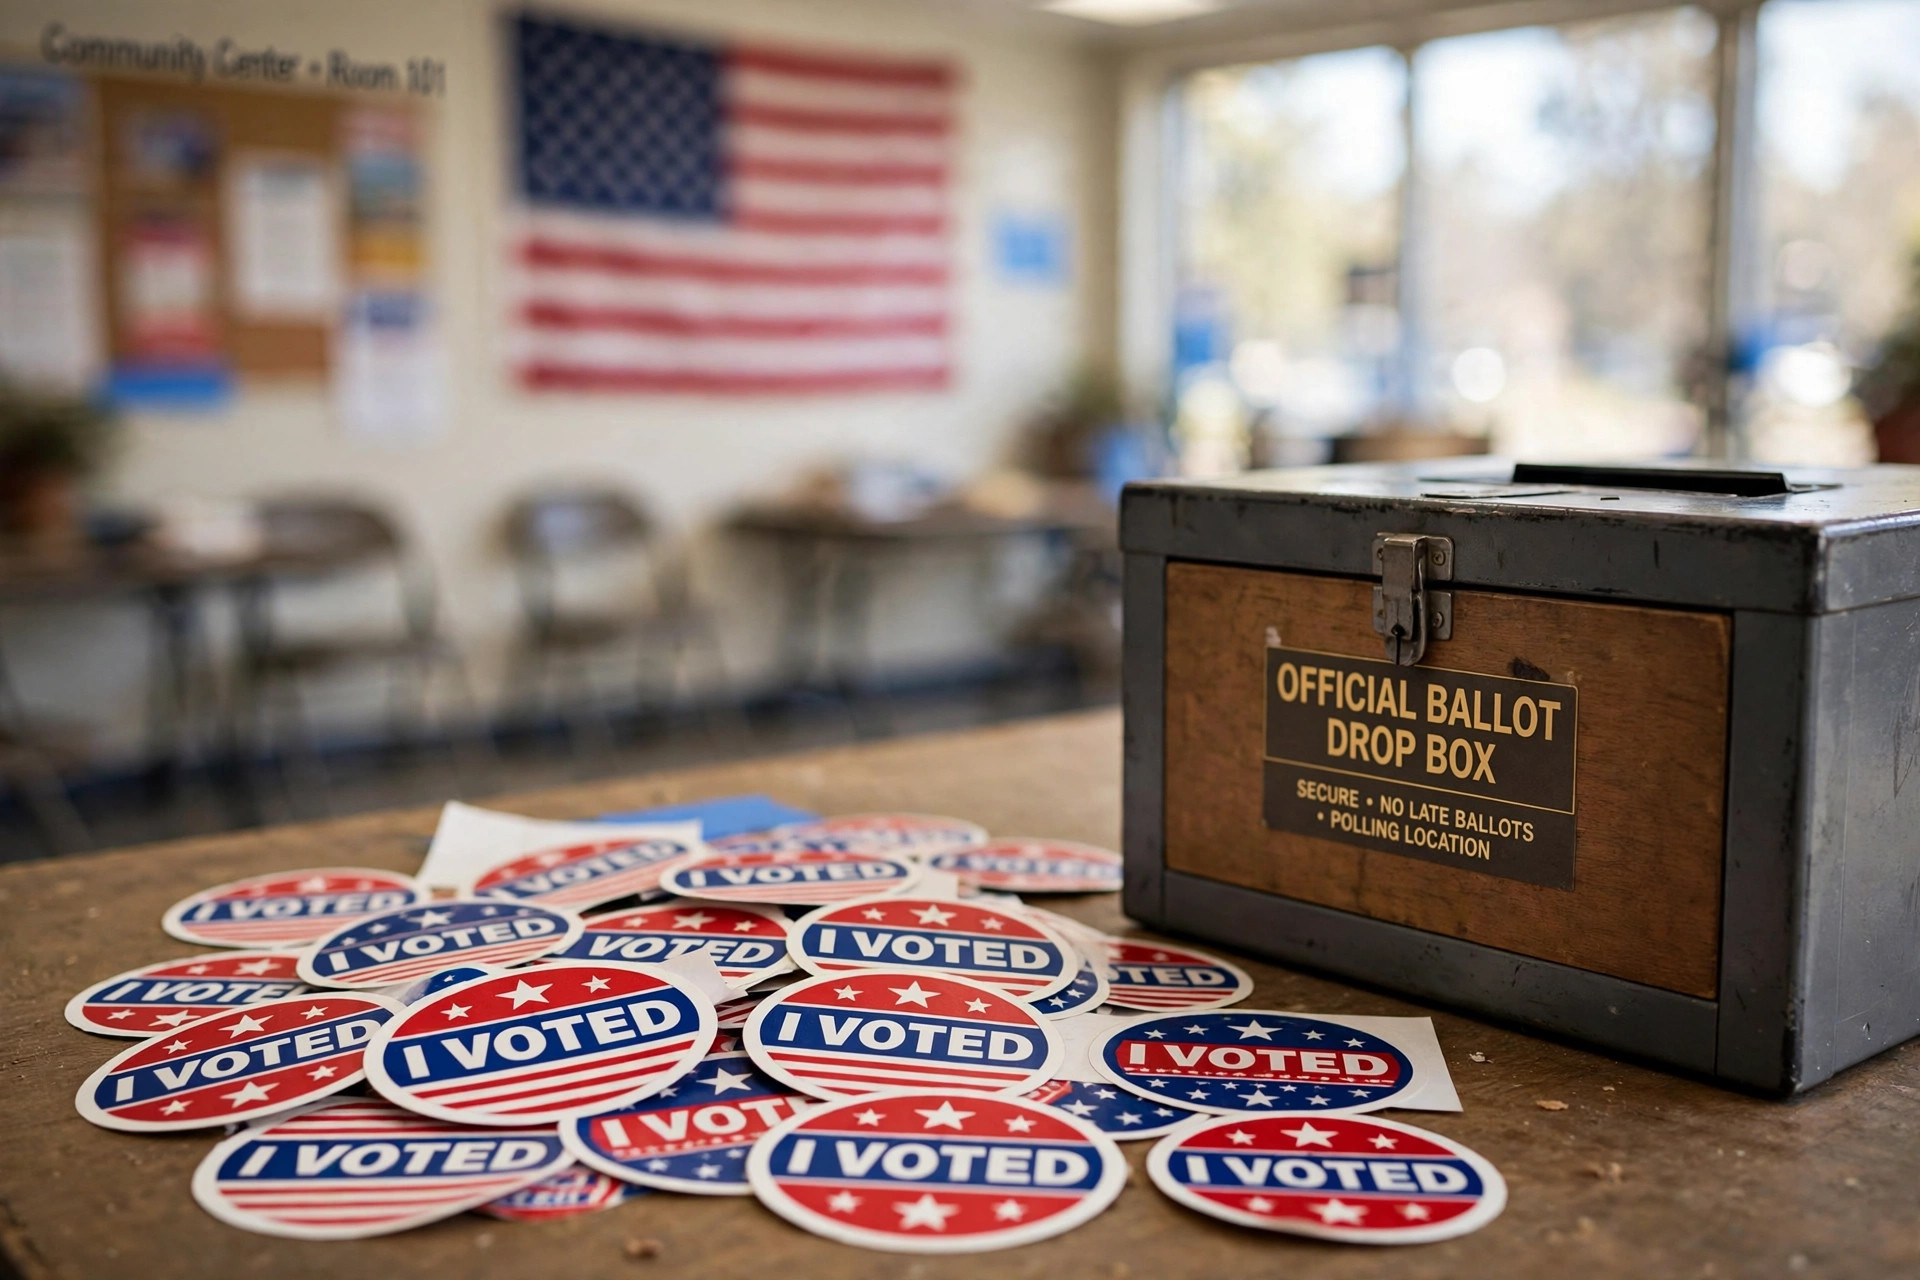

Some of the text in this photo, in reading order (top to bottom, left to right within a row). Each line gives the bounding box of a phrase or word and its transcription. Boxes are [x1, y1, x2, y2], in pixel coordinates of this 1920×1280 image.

[41, 22, 447, 96] Community Center Room 101
[1277, 662, 1561, 741] OFFICIAL BALLOT
[1327, 718, 1496, 784] DROP BOX
[1297, 779, 1534, 842] SECURE NO LATE BALLOTS
[1330, 811, 1490, 860] POLLING LOCATION
[515, 843, 676, 892] VOTED
[690, 863, 897, 886] I VOTED
[193, 892, 405, 921] I VOTED
[329, 916, 555, 972] I VOTED
[818, 928, 1051, 971] I VOTED
[103, 981, 307, 1003] I VOTE
[1108, 965, 1226, 986] TED
[115, 1019, 382, 1101] I VOTED
[403, 1000, 682, 1079] I VOTED
[778, 1012, 1033, 1062] I VOTED
[1129, 1043, 1389, 1077] I VOTED
[601, 1118, 631, 1148] I
[238, 1141, 548, 1177] I VOTED
[786, 1139, 1090, 1187] I VOTED
[1186, 1155, 1469, 1193] I VOTED
